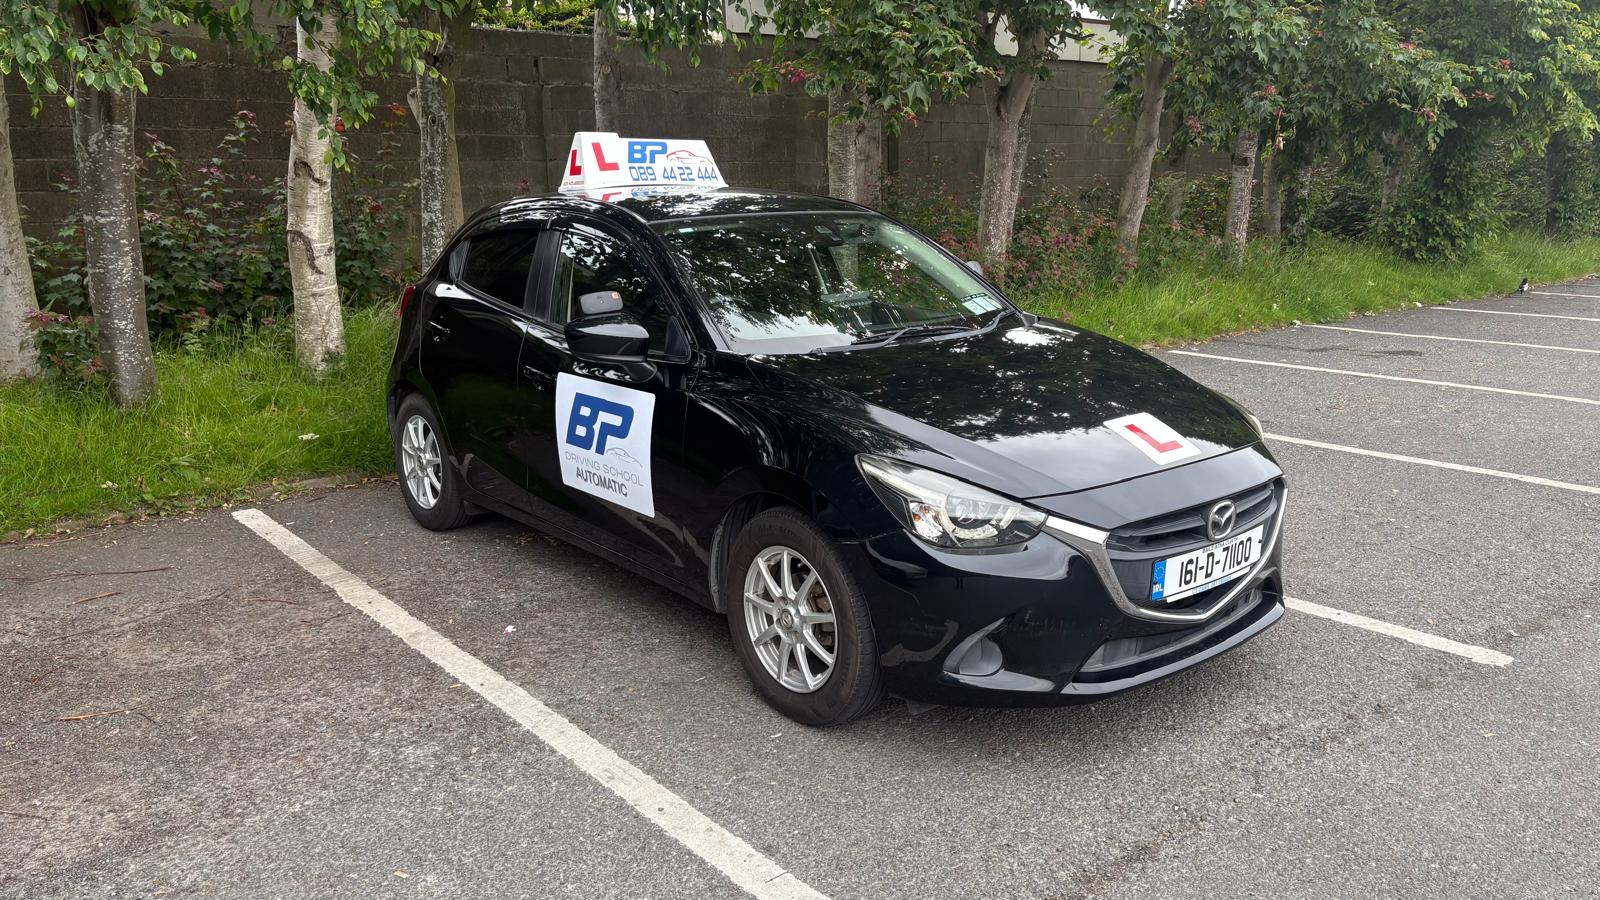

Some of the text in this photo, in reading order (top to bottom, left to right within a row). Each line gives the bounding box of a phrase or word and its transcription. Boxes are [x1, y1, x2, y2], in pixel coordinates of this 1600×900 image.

[569, 149, 582, 176] L
[591, 142, 620, 171] L
[628, 141, 667, 164] BP
[628, 166, 657, 182] 089
[662, 166, 678, 182] 44
[697, 166, 719, 182] 444
[566, 391, 634, 456] BP
[1124, 423, 1184, 454] L
[564, 450, 644, 487] DRIVING SCHOOL
[576, 466, 628, 497] AUTOMATIC
[1179, 536, 1252, 588] 161-D-71100
